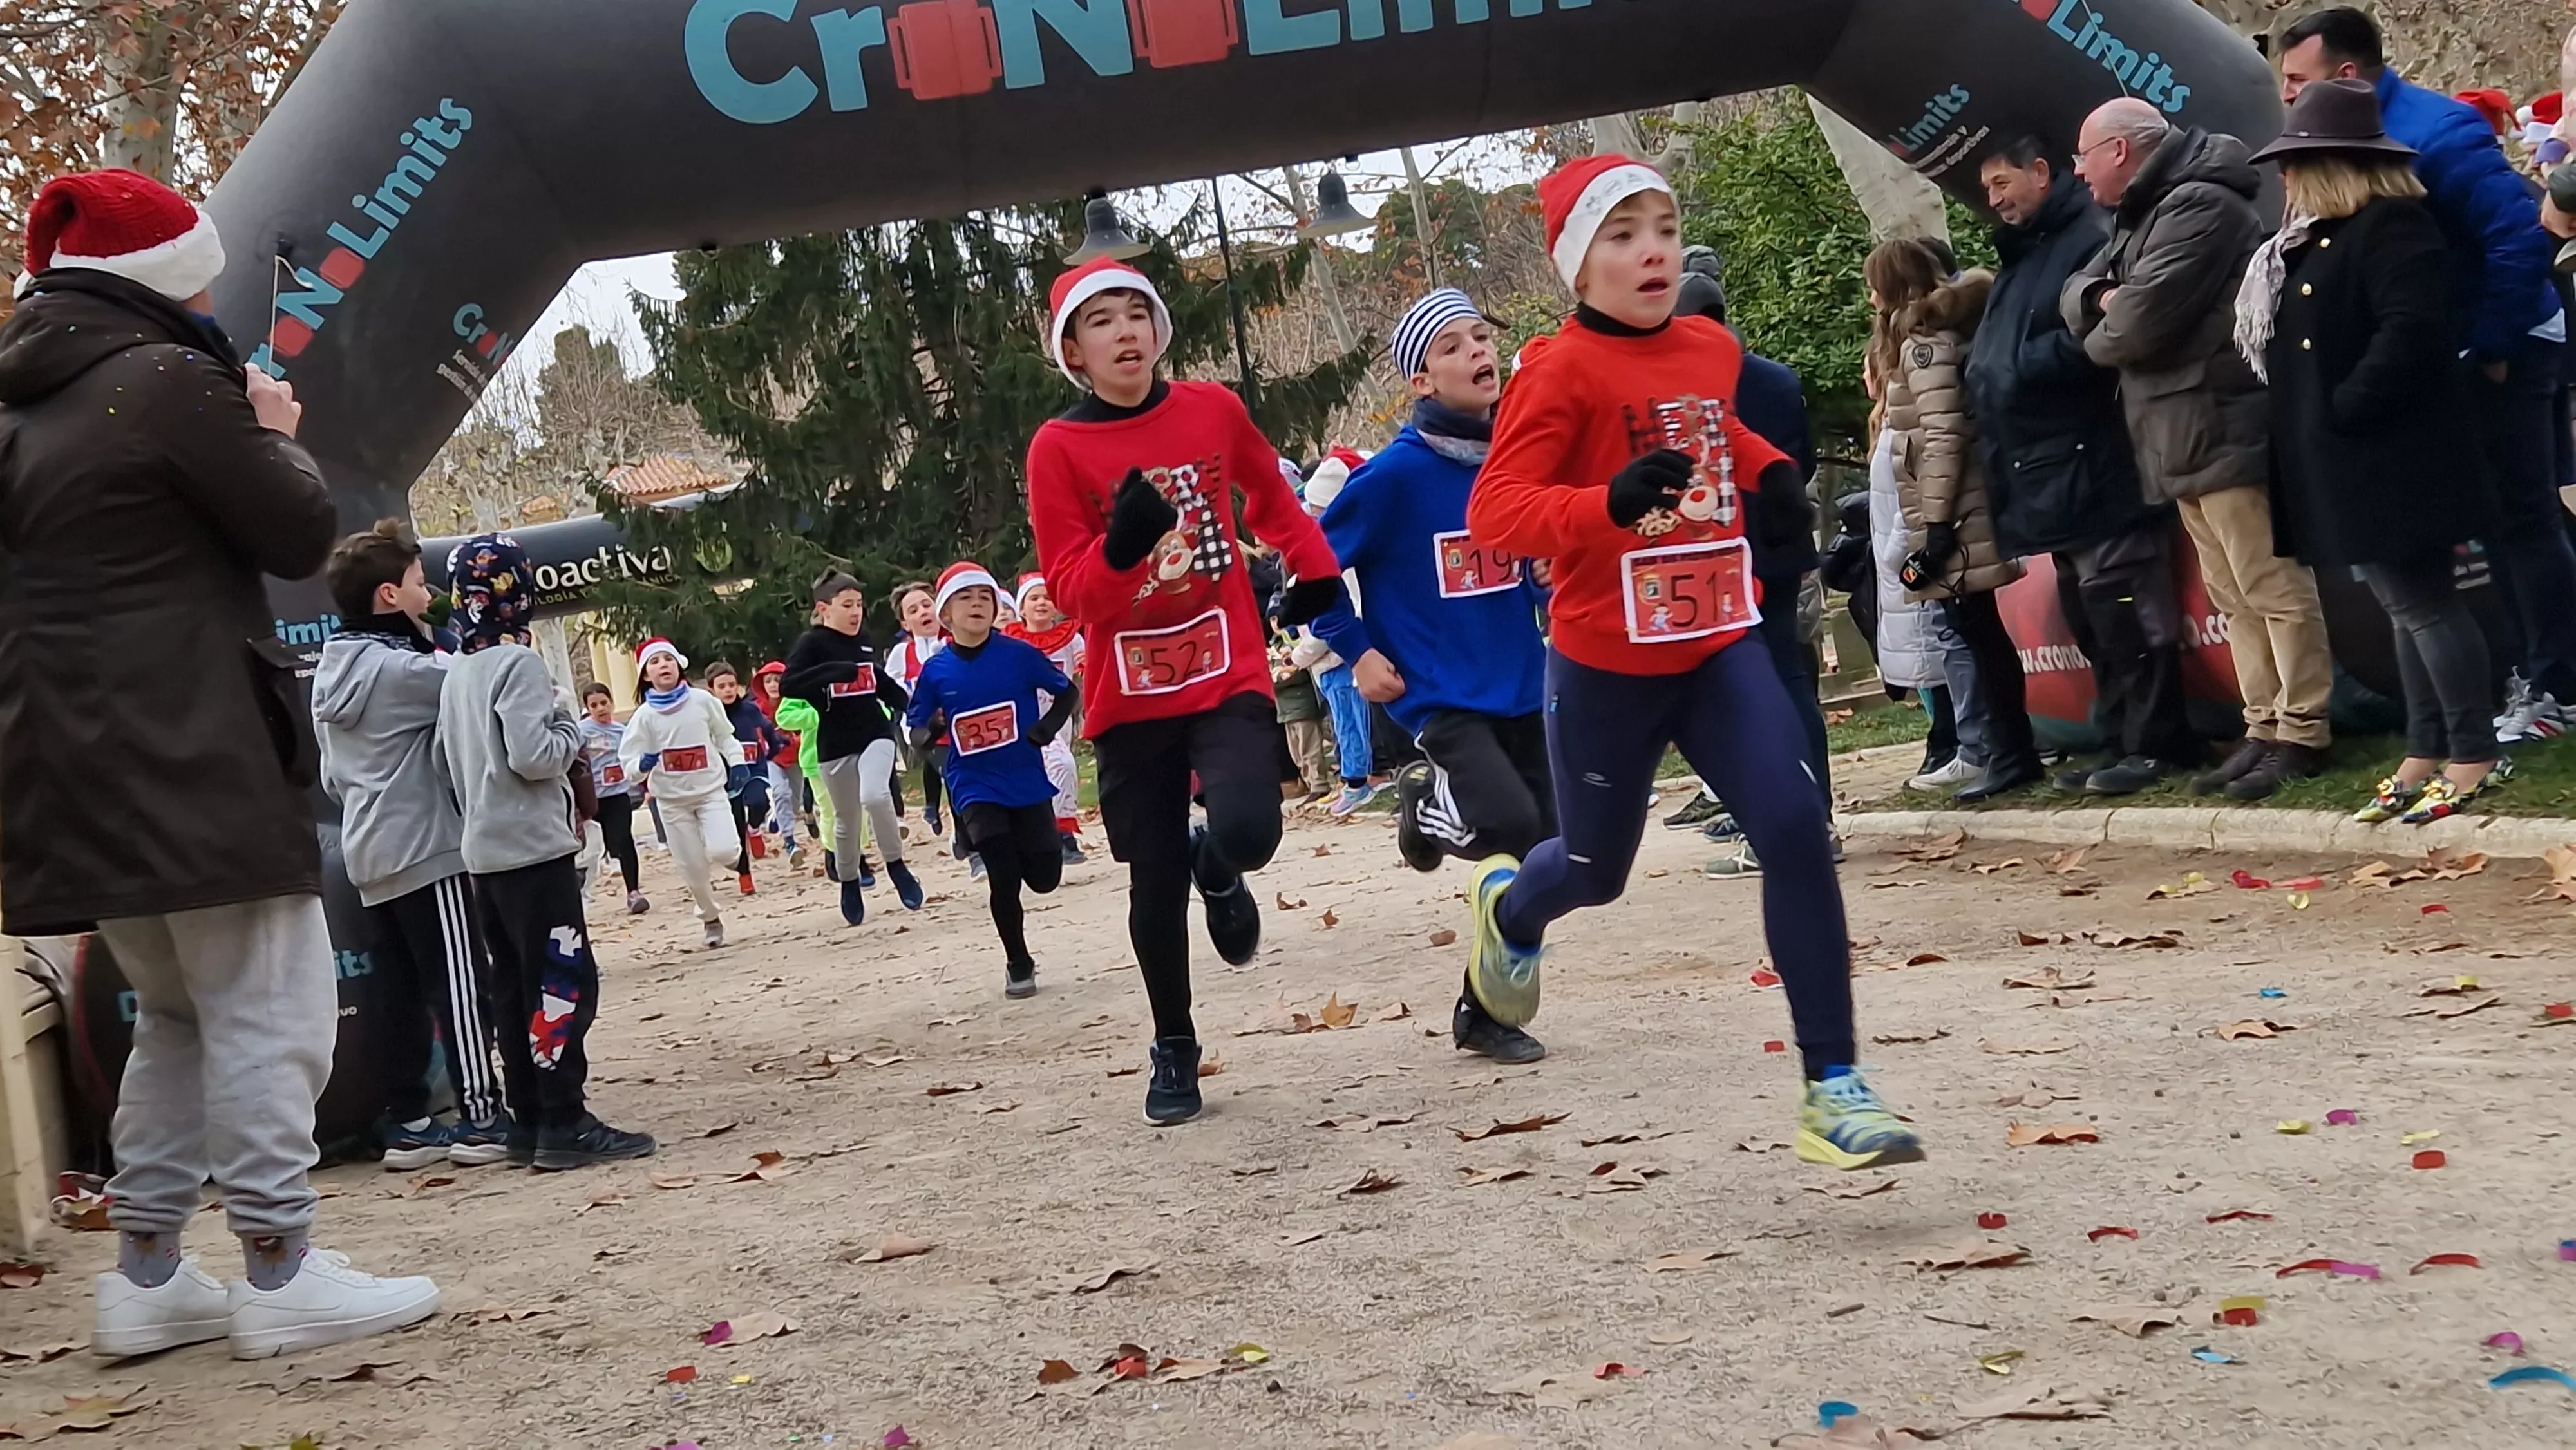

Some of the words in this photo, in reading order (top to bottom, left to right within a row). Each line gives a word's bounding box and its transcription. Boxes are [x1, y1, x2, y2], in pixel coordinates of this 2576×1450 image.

[534, 543, 672, 592] oactiva
[1469, 548, 1512, 585] 19
[1671, 570, 1718, 627] 51
[1150, 640, 1204, 684] 52
[967, 717, 1003, 748] 35
[672, 751, 696, 772] 47
